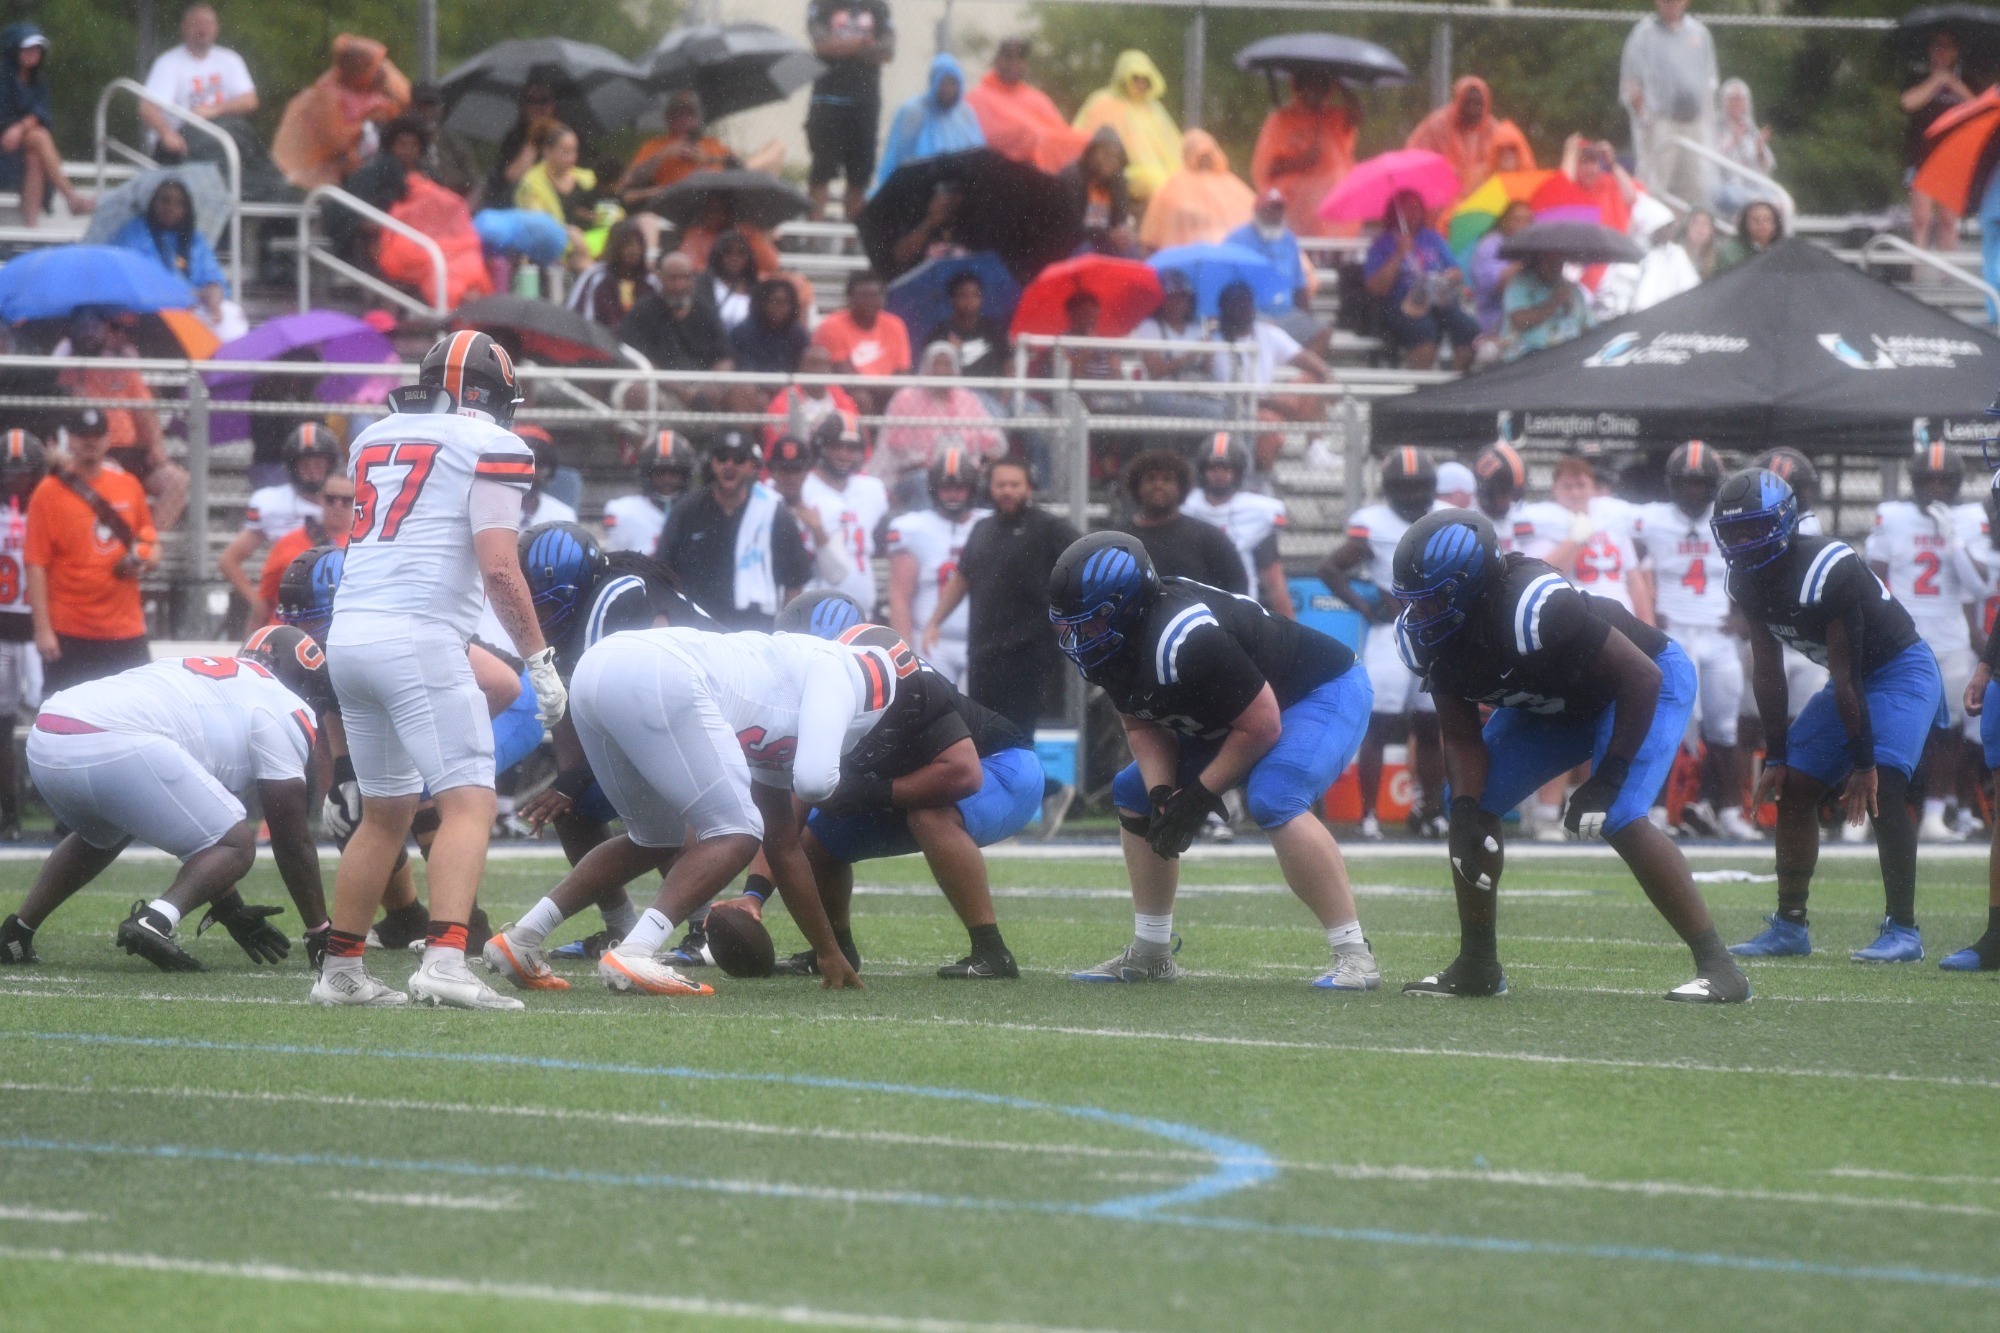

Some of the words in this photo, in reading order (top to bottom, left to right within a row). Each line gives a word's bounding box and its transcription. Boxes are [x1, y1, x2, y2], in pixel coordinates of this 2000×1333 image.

[1524, 412, 1595, 437] Lexington
[1597, 412, 1641, 436] Clinic
[350, 443, 443, 543] 57
[1682, 558, 1707, 595] 4
[1914, 550, 1940, 596] 2
[328, 971, 360, 997] NIKE
[1147, 960, 1170, 978] NIKE
